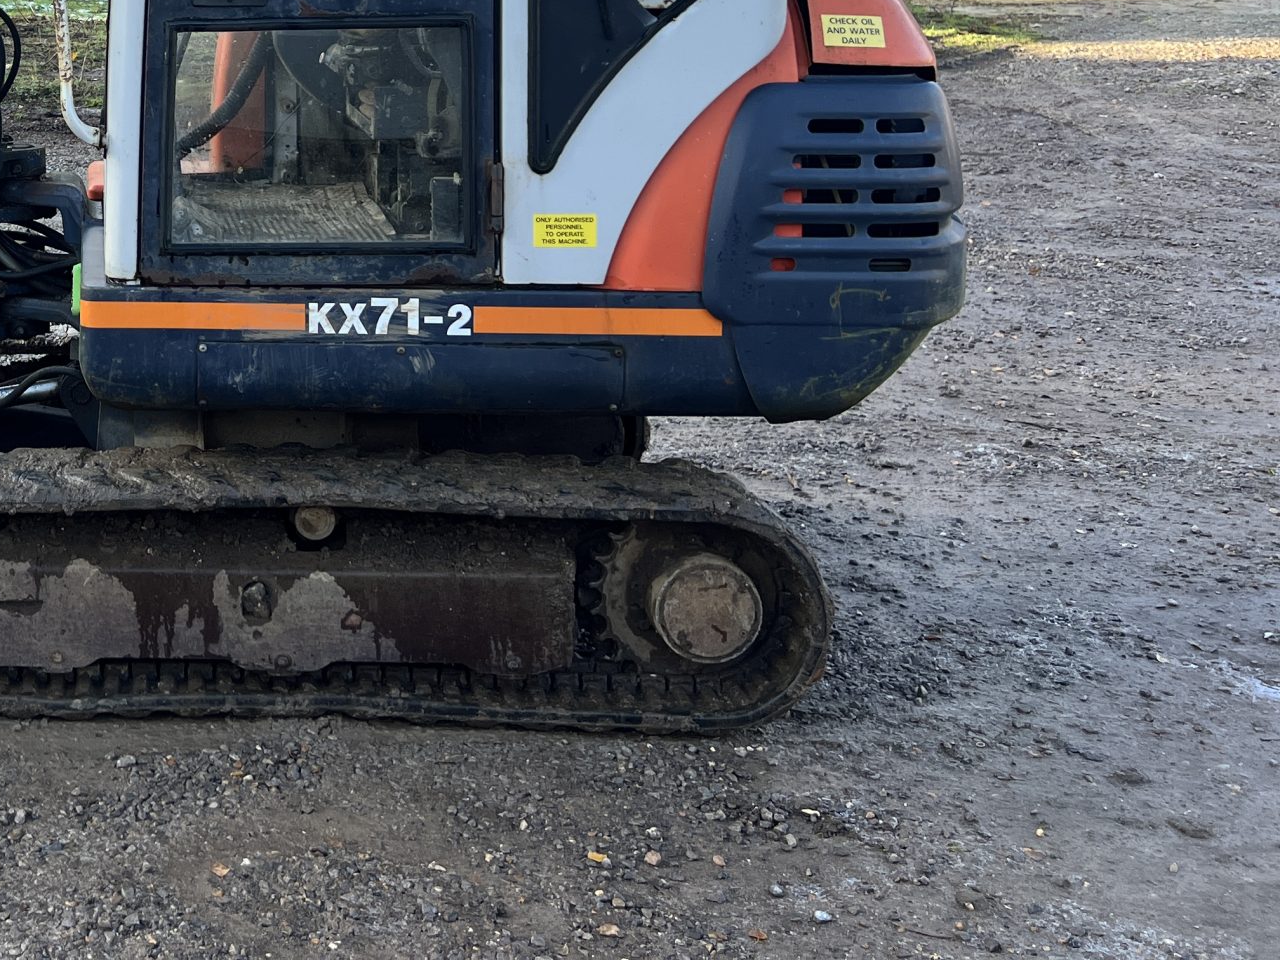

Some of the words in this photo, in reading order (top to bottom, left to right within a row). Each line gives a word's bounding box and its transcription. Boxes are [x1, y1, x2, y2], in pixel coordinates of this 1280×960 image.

[829, 17, 858, 25] CHECK
[861, 18, 875, 26] OIL
[841, 37, 867, 45] DAILY
[308, 297, 471, 336] KX71-2
